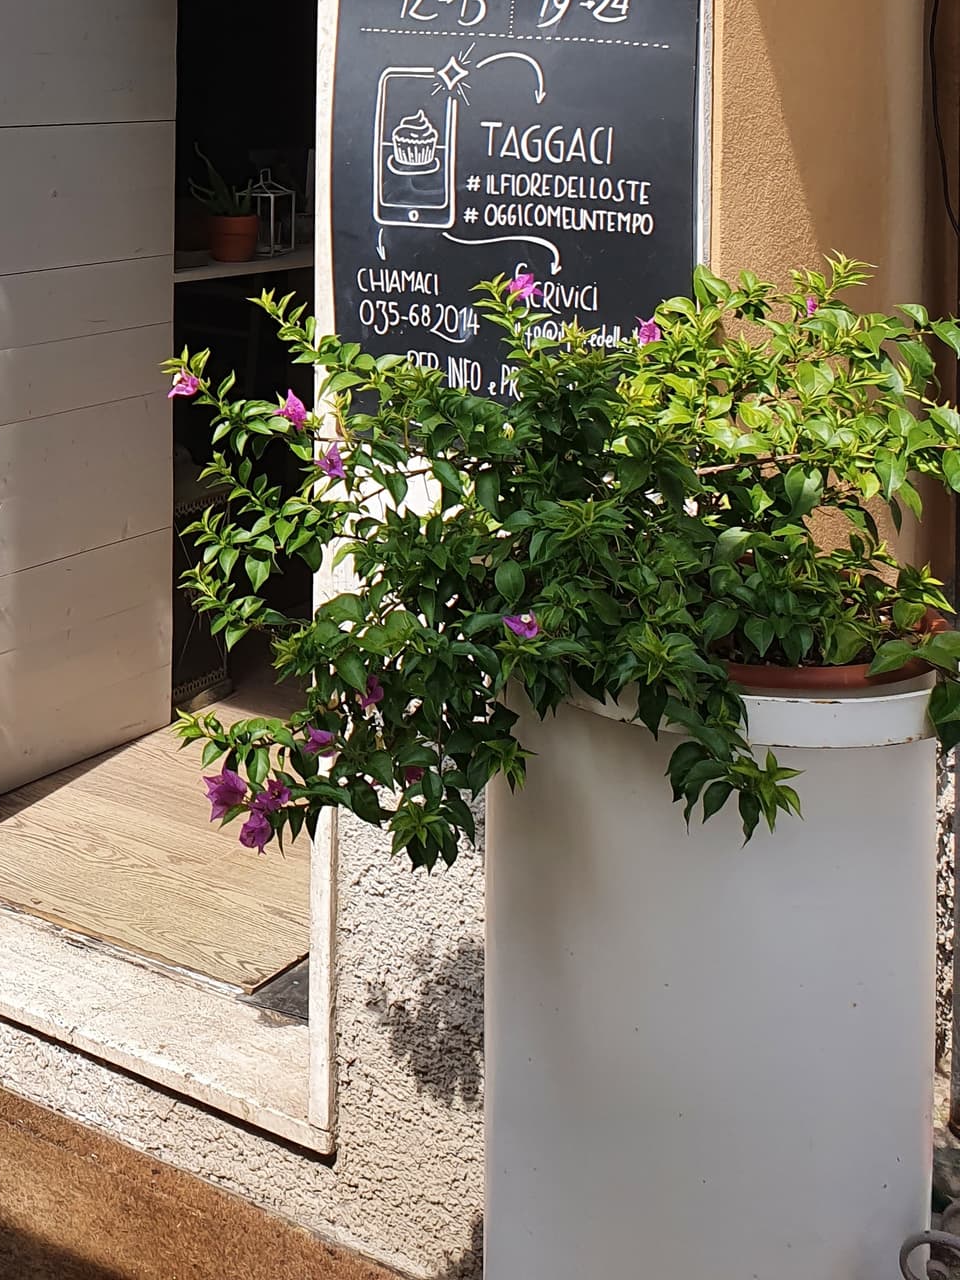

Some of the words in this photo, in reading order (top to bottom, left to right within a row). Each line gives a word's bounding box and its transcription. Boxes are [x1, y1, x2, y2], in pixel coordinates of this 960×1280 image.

[480, 121, 614, 165] TAGGACI
[357, 267, 439, 296] CHIAMACI
[447, 355, 481, 391] INFO
